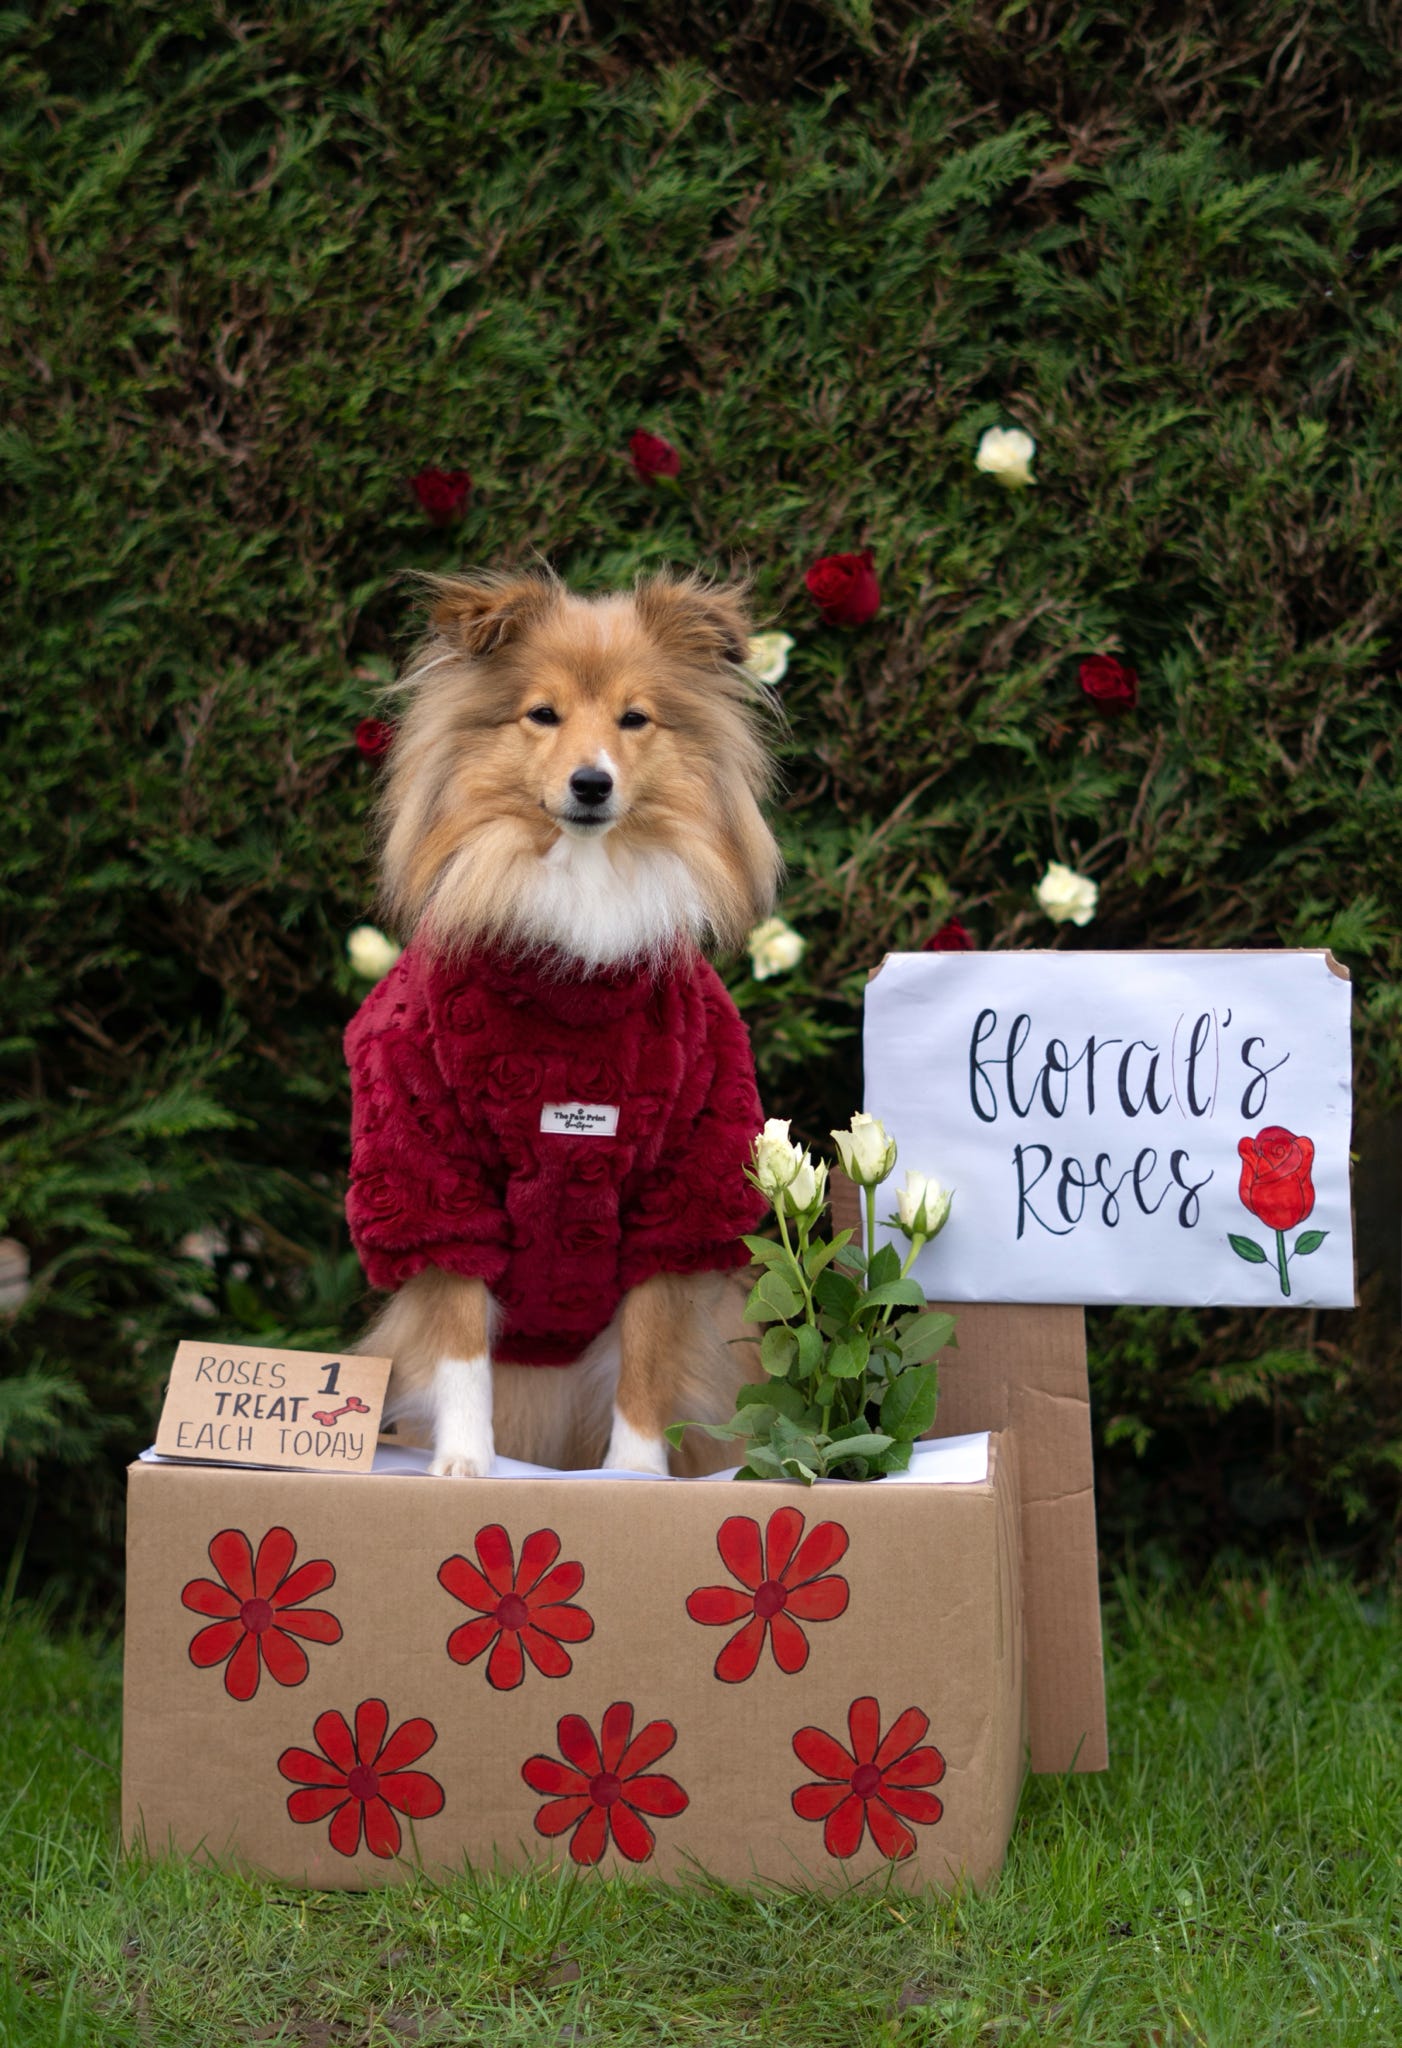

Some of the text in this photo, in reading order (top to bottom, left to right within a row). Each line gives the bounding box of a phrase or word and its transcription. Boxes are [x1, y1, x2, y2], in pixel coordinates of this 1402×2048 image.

[554, 1111, 568, 1119] The
[1011, 1143, 1215, 1240] Roses
[195, 1356, 341, 1396] ROSES 1
[214, 1392, 310, 1423] TREAT
[176, 1421, 364, 1461] EACH TODAY
